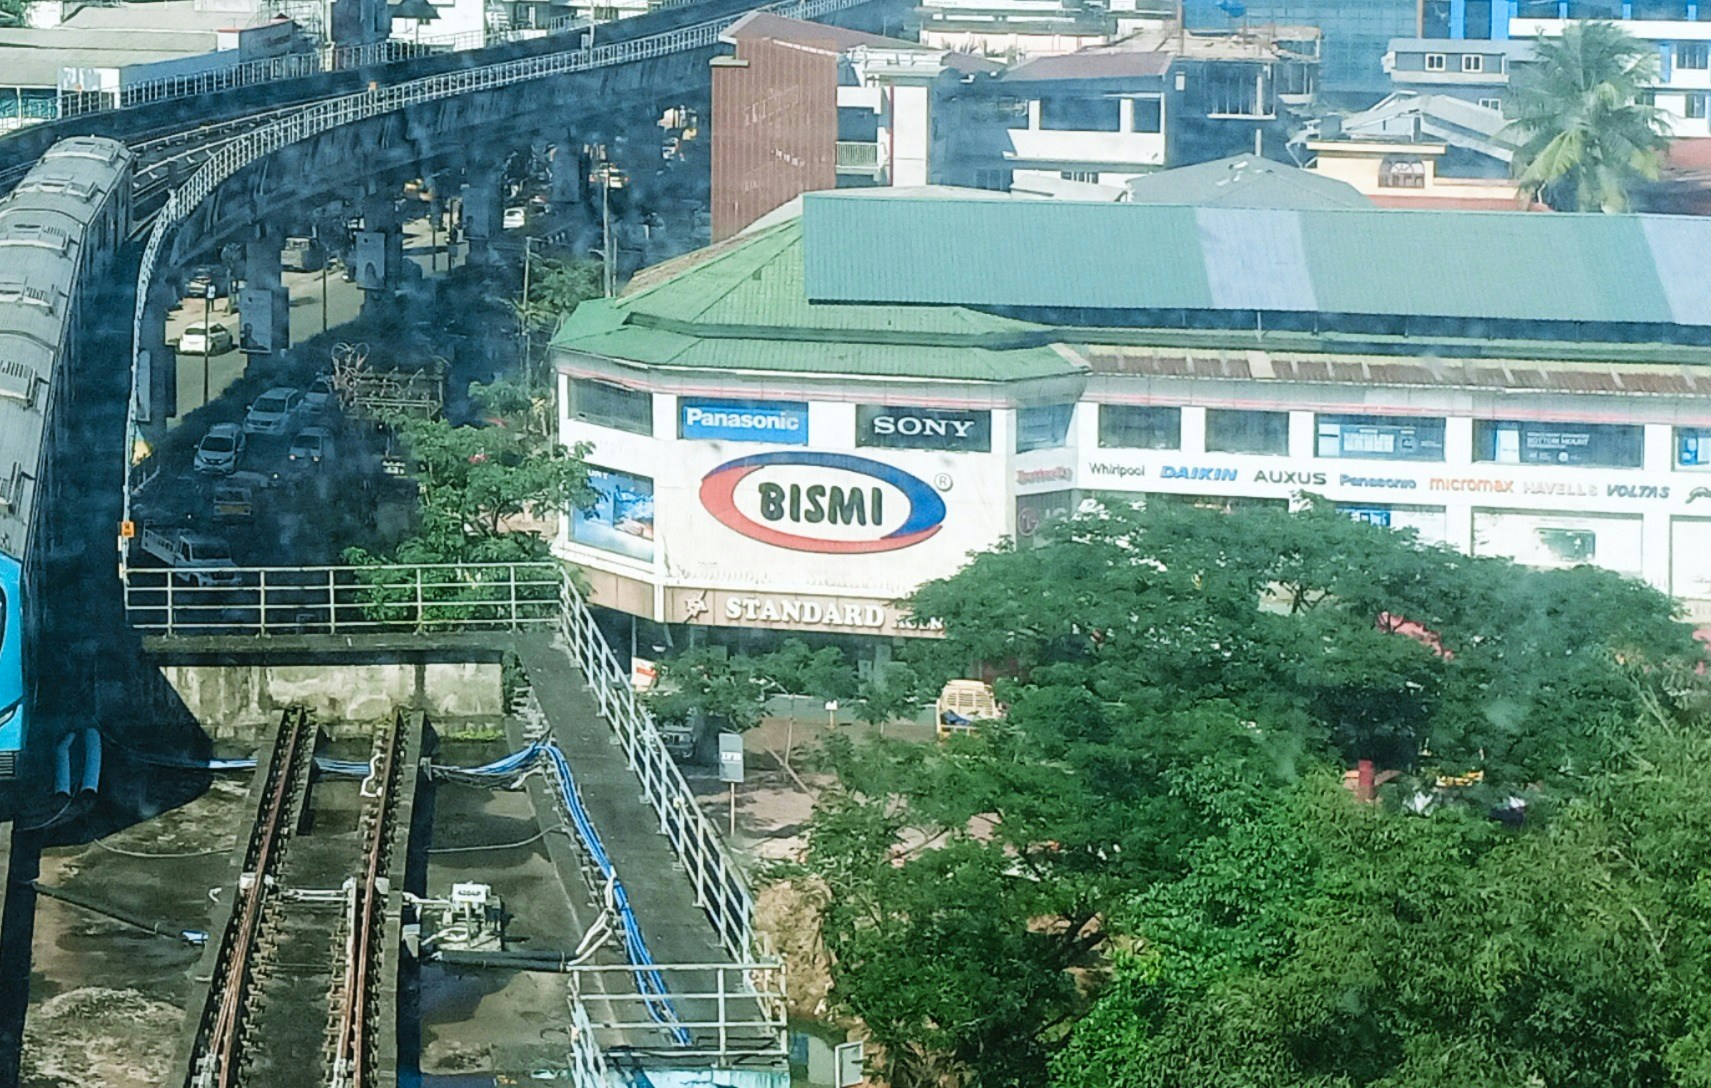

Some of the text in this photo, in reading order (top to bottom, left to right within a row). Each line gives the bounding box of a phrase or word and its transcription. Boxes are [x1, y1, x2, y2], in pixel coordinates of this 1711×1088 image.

[686, 406, 801, 431] Panasonic
[873, 416, 975, 438] SONY
[1089, 462, 1145, 478] Whirlpool
[1160, 465, 1239, 482] DAIKIN
[1254, 469, 1328, 486] AUXUS
[1340, 473, 1417, 489] Panasonic
[1429, 477, 1514, 493] micromax
[1523, 482, 1598, 497] HAVELLS
[1606, 484, 1671, 499] VOLTAS
[757, 481, 883, 527] BISMI
[725, 596, 886, 628] STANDARD
